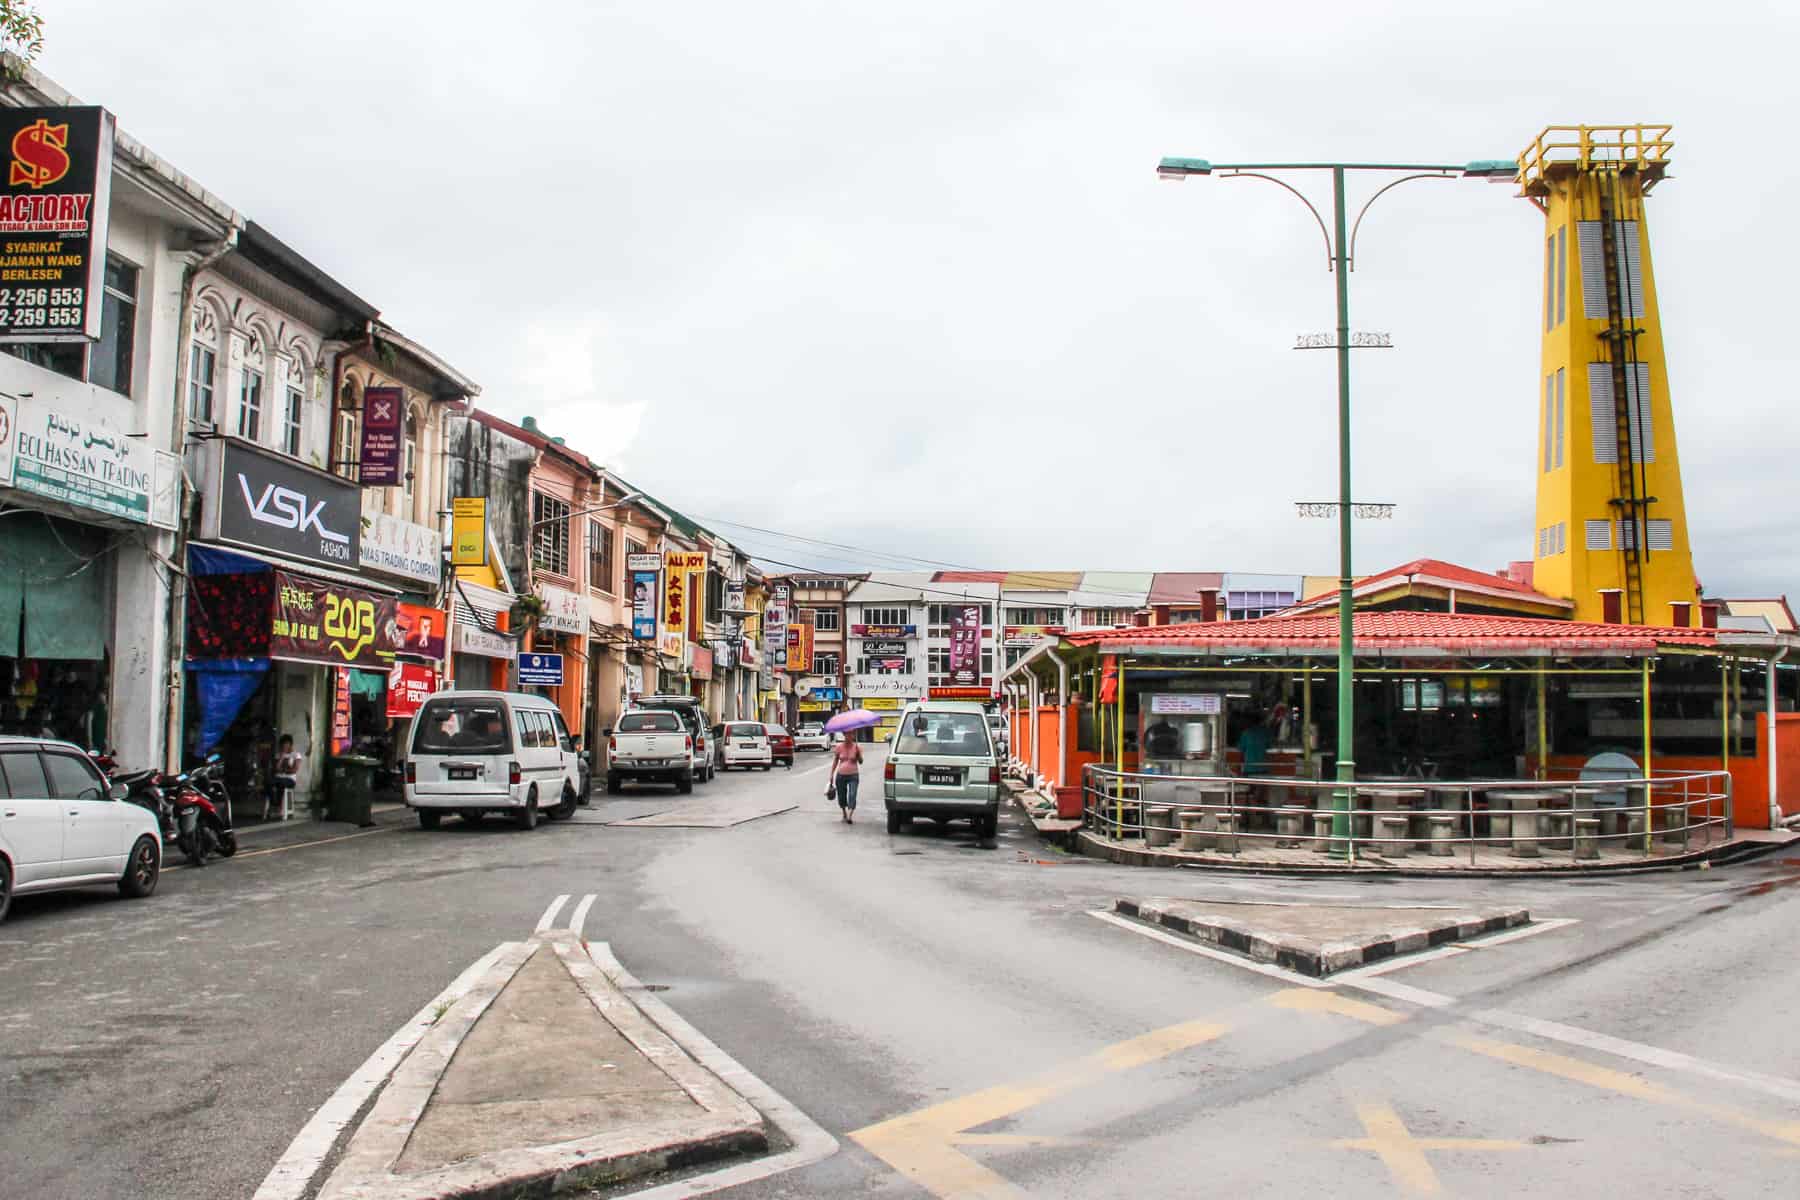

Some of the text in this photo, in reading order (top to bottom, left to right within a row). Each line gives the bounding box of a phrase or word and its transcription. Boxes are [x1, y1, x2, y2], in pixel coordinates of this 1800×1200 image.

[5, 242, 63, 253] SYARIKAT
[47, 255, 82, 266] WANG
[2, 269, 62, 280] BERLESEN
[50, 288, 83, 306] 553
[49, 308, 81, 326] 553
[102, 459, 149, 492] TRADING
[237, 472, 350, 545] VSK
[320, 539, 350, 561] FASHION
[381, 550, 409, 571] TRADING
[668, 556, 684, 567] ALL
[686, 556, 704, 568] JOY
